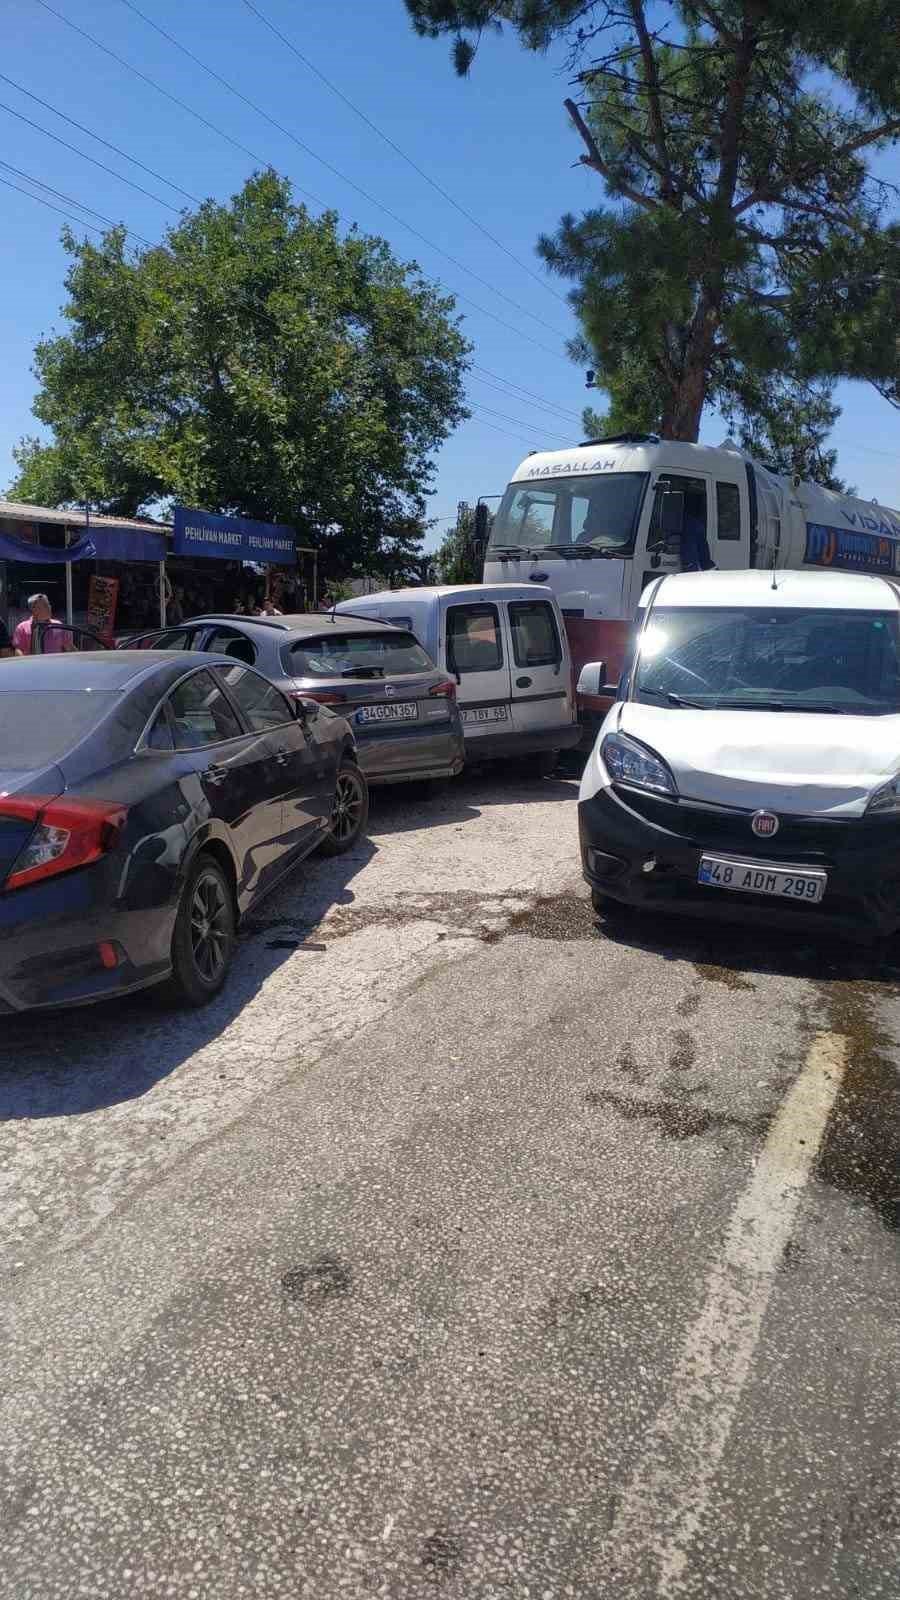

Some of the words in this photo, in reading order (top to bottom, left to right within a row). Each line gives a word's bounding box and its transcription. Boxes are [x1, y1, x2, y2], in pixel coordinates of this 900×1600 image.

[528, 460, 616, 477] MASALLAH
[218, 531, 242, 545] MARKET
[274, 538, 294, 552] MARKET
[757, 819, 774, 833] FIAT
[711, 865, 734, 883] 48
[742, 870, 778, 892] ADM
[782, 878, 817, 898] 299
